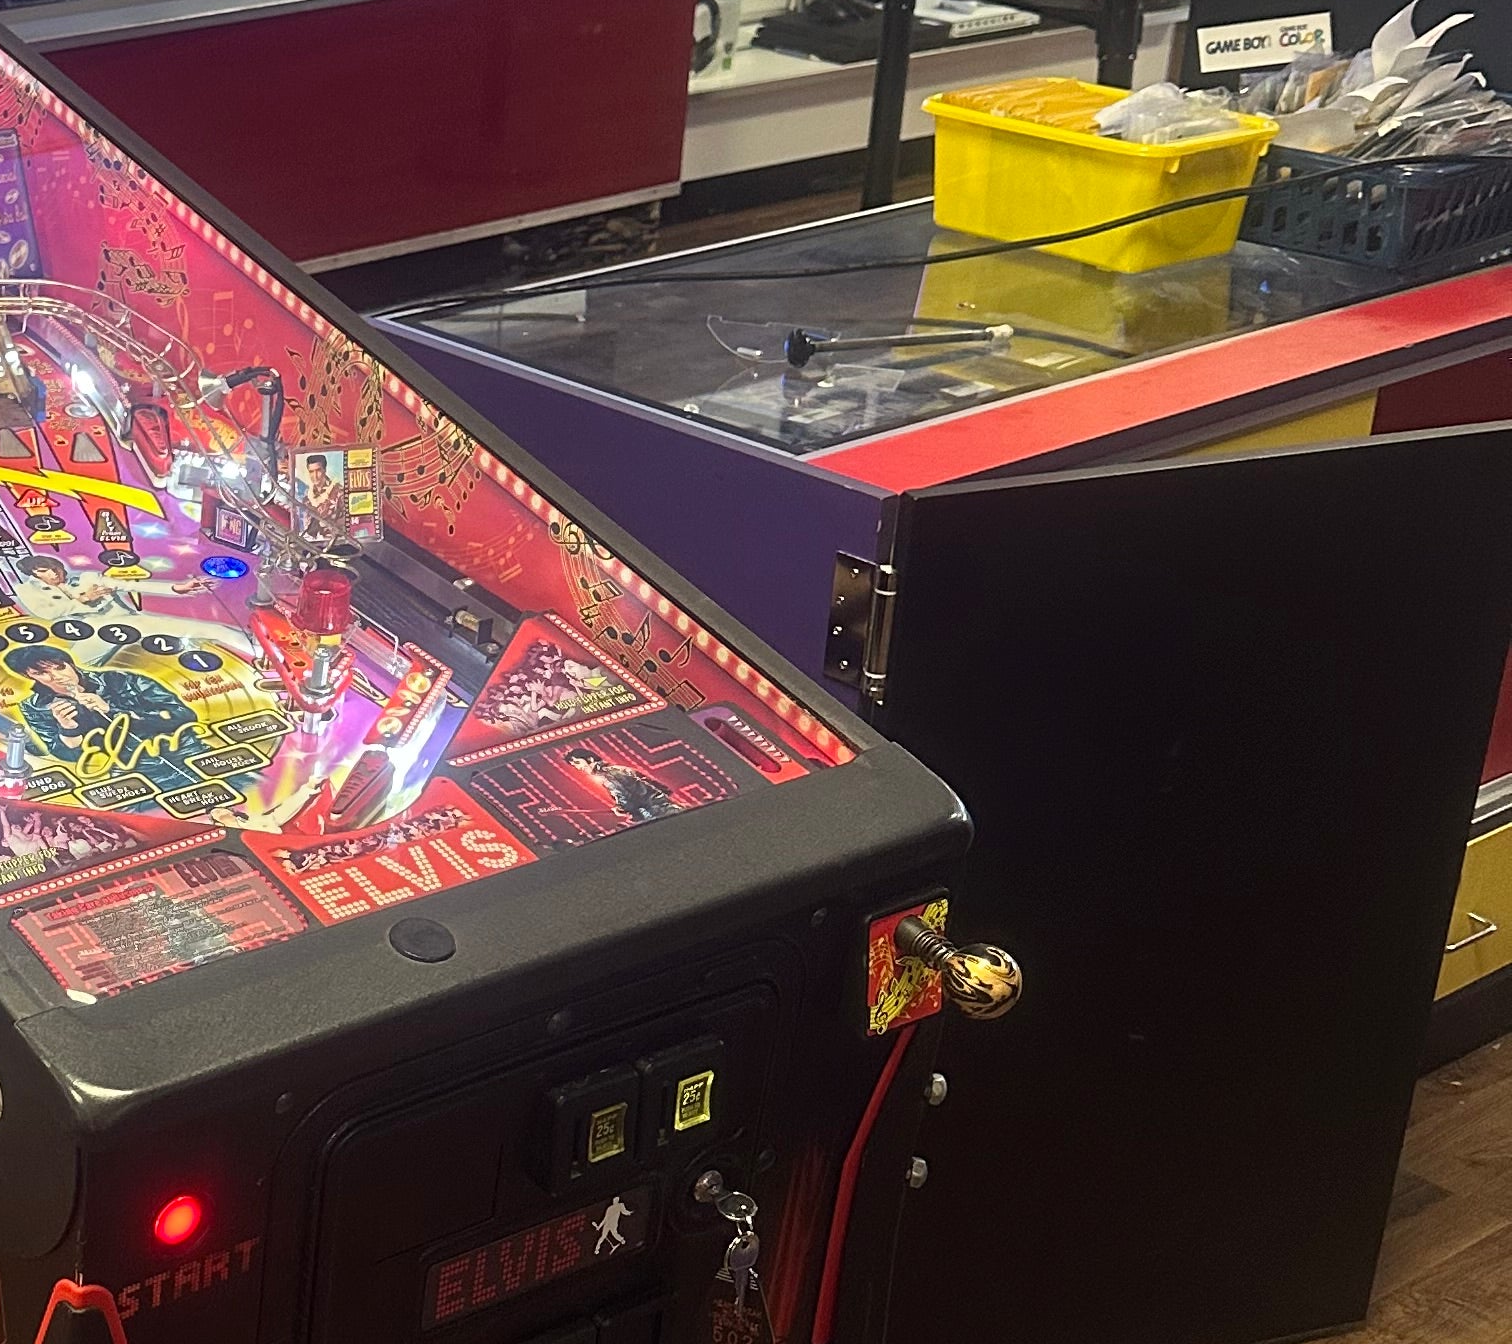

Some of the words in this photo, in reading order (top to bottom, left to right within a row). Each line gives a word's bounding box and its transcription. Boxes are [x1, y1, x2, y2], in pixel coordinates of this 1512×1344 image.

[1205, 38, 1241, 55] GAME
[1243, 36, 1268, 51] BOY
[1279, 28, 1326, 48] COLOR
[349, 470, 371, 489] ELVIS
[17, 625, 35, 641] 5
[64, 622, 81, 638] 4
[110, 627, 129, 642] 3
[152, 636, 174, 652] 2
[192, 653, 207, 669] 1
[581, 698, 617, 714] INSTANT
[616, 692, 637, 705] INFO
[227, 723, 244, 732] ALL
[237, 722, 269, 736] SHOOK
[265, 723, 279, 733] UP
[199, 756, 222, 767] JAIL
[212, 755, 244, 769] HOUSE
[230, 757, 258, 770] ROCK
[41, 780, 67, 794] DOG
[89, 785, 113, 798] BLUE
[99, 785, 130, 800] SUEDE
[116, 787, 148, 802] SHOES
[167, 790, 201, 804] HEART
[182, 791, 217, 806] BREAK
[199, 792, 231, 807] HOTEL
[37, 847, 60, 862] FOR
[22, 862, 48, 881] INFO
[299, 828, 520, 922] ELVIS
[682, 1090, 702, 1106] 25¢
[595, 1121, 615, 1138] 25¢
[434, 1213, 589, 1320] ELVIS
[118, 1236, 261, 1320] START
